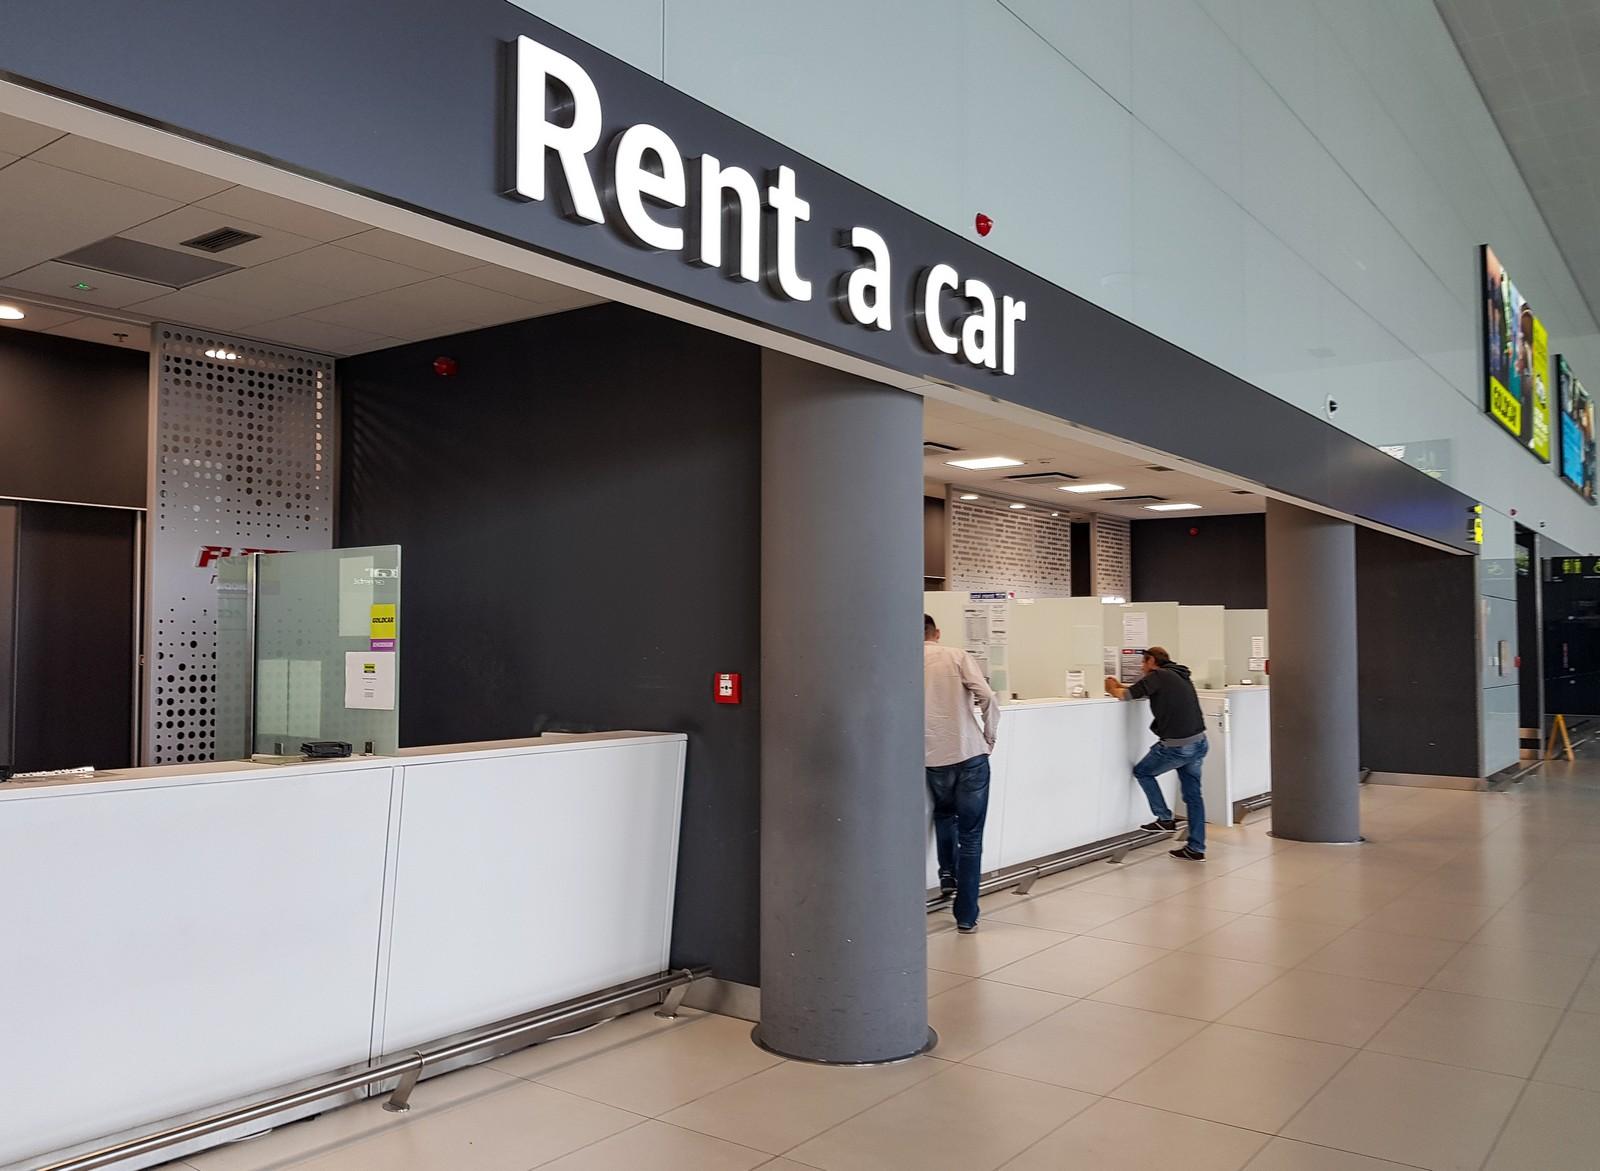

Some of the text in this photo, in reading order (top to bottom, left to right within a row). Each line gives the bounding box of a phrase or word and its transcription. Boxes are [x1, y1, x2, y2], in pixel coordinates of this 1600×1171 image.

[515, 34, 1027, 376] Rent a car
